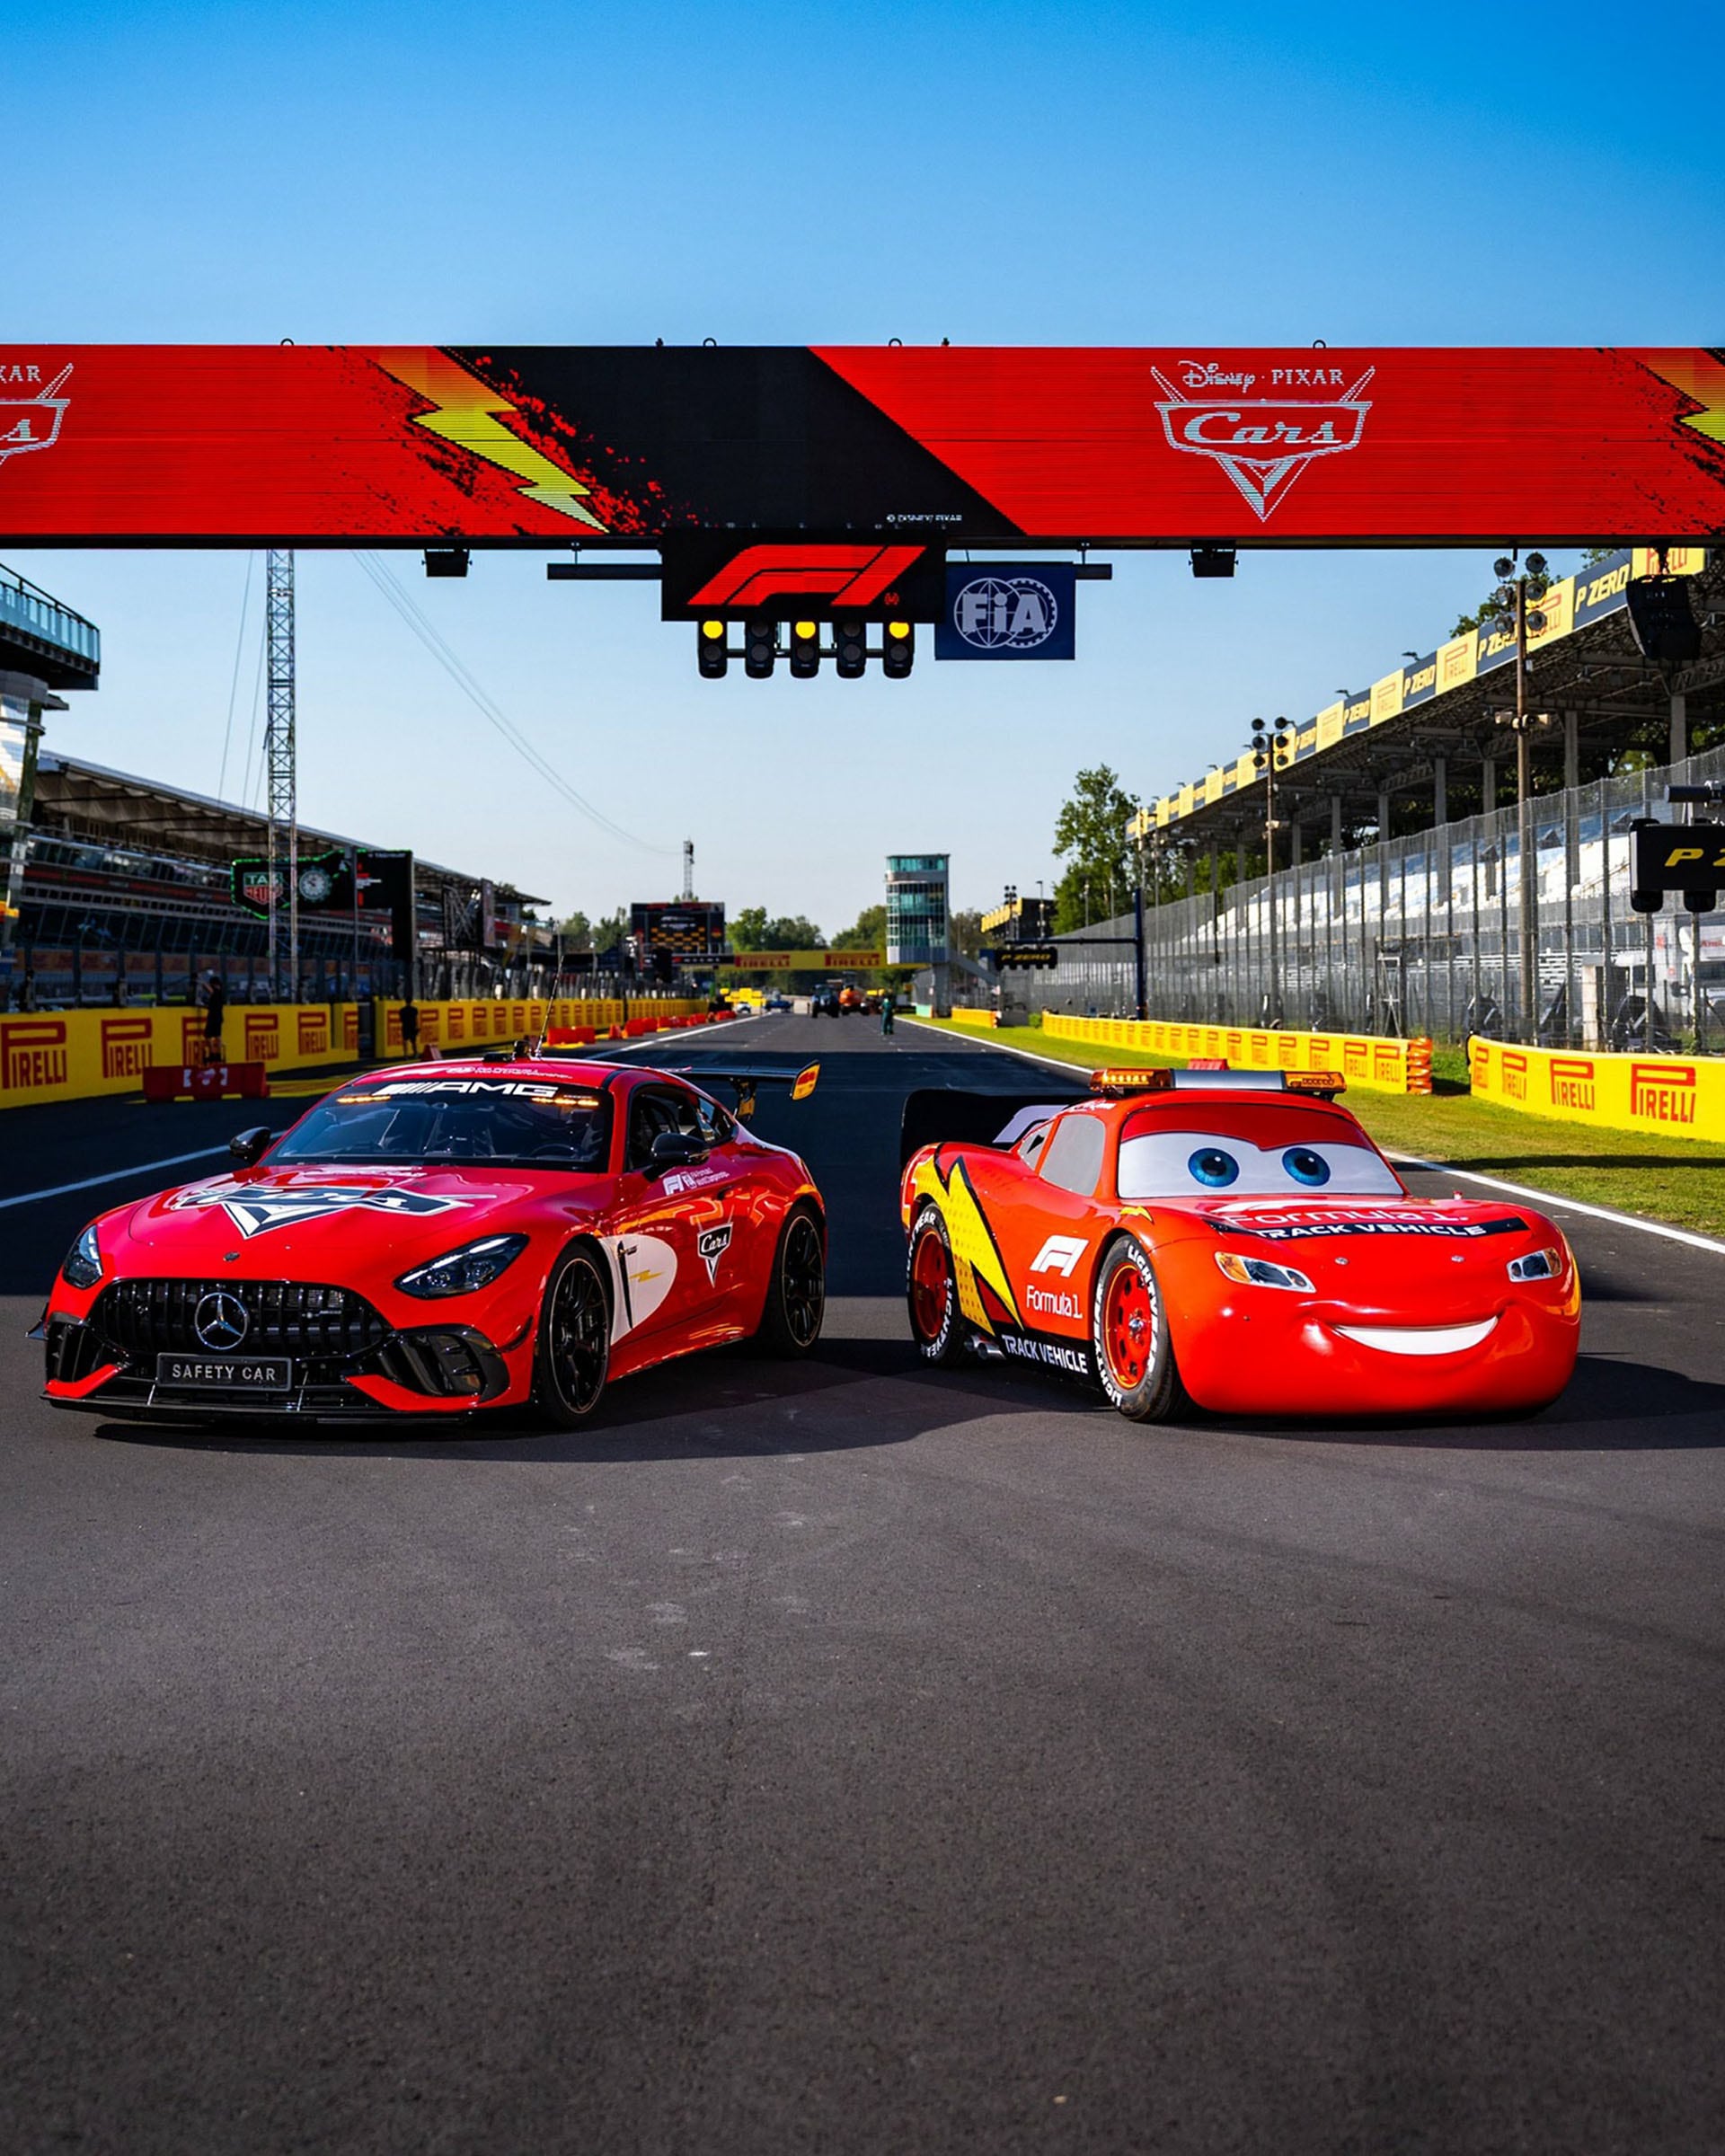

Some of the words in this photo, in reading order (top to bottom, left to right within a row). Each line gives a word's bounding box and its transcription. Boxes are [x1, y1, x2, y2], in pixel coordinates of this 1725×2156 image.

[1178, 360, 1255, 393] Disney
[1271, 369, 1345, 386] PIXAR
[1183, 411, 1342, 444] Cars
[686, 544, 927, 606] F1
[1574, 591, 1587, 613] P
[1586, 563, 1631, 607] ZERO
[1664, 848, 1704, 867] P
[1, 1021, 67, 1090] PIRELLI
[101, 1018, 153, 1079] PIRELLI
[245, 1013, 279, 1061] PIRELLI
[1375, 1045, 1401, 1082] PIRELLI
[1502, 1051, 1527, 1100] PIRELLI
[425, 1081, 559, 1099] AMG
[1550, 1058, 1595, 1110] PIRELLI
[1631, 1064, 1696, 1124] PIRELLI
[701, 1233, 727, 1253] Cars
[1355, 1224, 1487, 1236] VEHICLE
[172, 1364, 234, 1379] SAFETY
[242, 1366, 276, 1381] CAR
[1002, 1334, 1039, 1361] TRACK
[1039, 1343, 1089, 1374] VEHICLE
